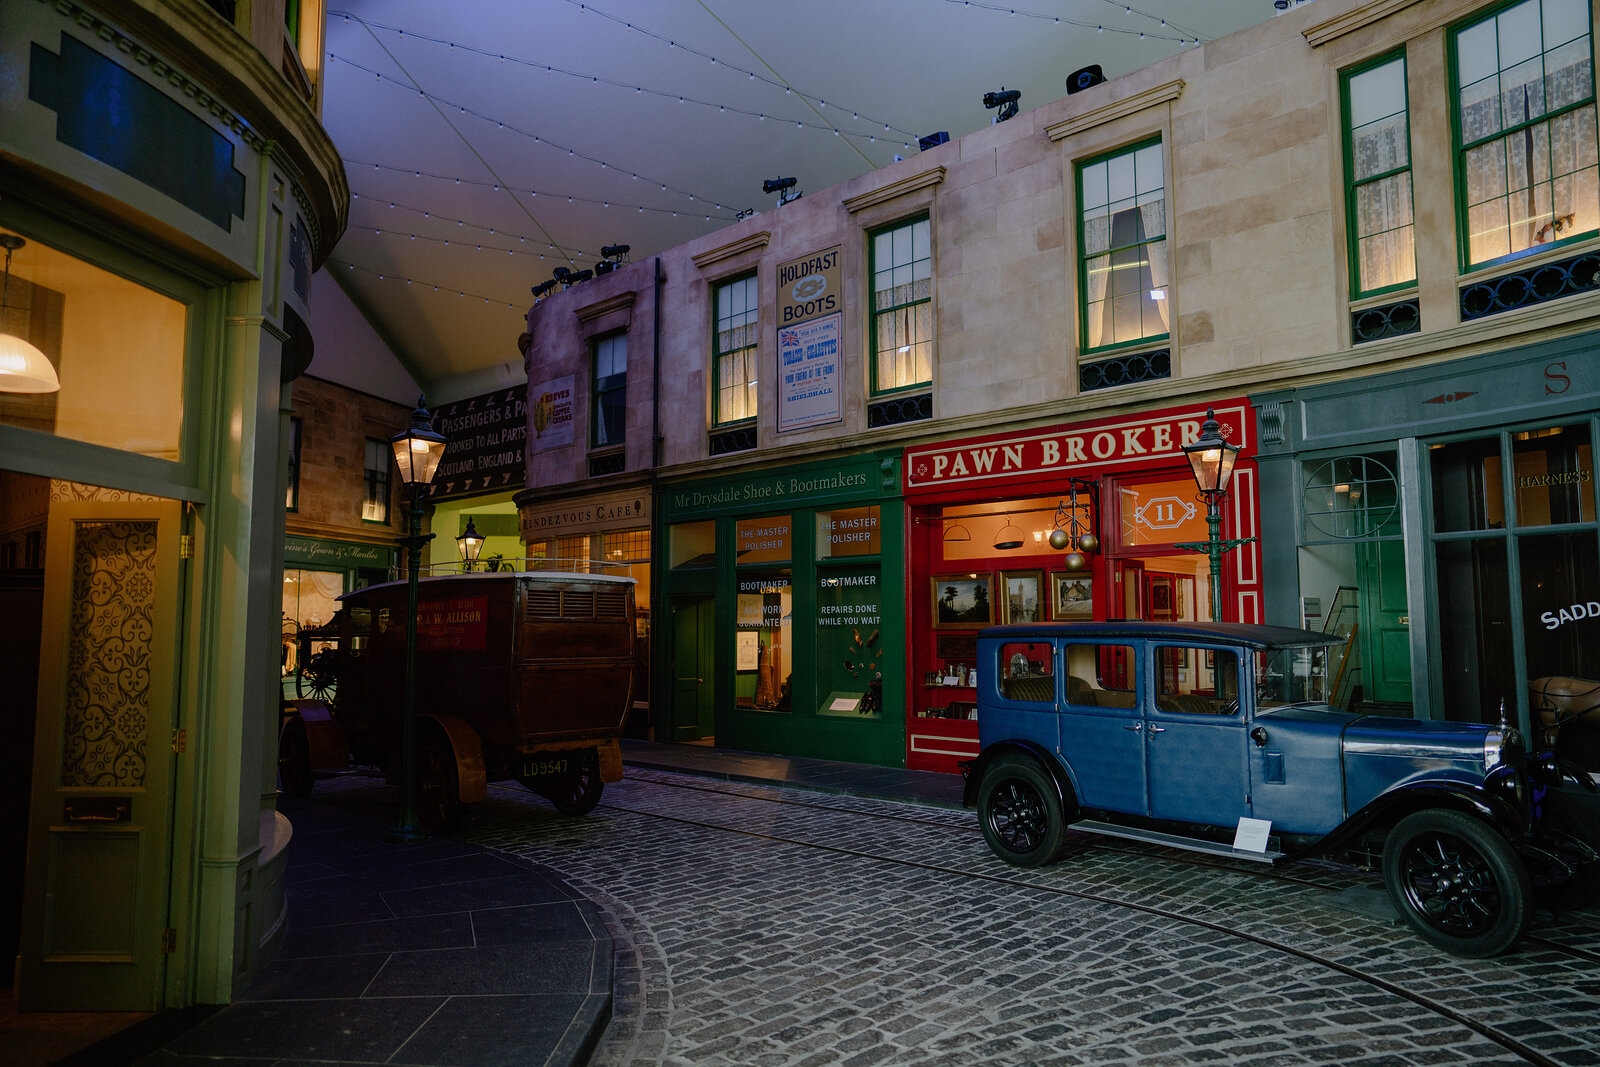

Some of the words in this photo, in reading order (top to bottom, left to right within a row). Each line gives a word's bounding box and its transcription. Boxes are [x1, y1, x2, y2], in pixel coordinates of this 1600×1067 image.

[781, 251, 838, 288] HOLDFAST
[784, 294, 836, 322] BOOTS
[1544, 362, 1570, 395] S
[787, 388, 833, 402] SHIELDHALL
[442, 408, 502, 434] PASSENGERS
[504, 405, 512, 420] &
[447, 437, 474, 455] BOOKED
[476, 435, 485, 448] TO
[486, 431, 500, 446] ALL
[502, 426, 527, 443] PARTS
[932, 444, 1026, 480] PAWN
[1040, 419, 1202, 467] BROKER
[478, 451, 514, 470] ENGLAND
[515, 449, 522, 463] &
[1519, 470, 1590, 489] HARNESS
[674, 495, 690, 508] Mr
[692, 486, 740, 508] Drysdale
[744, 484, 772, 500] Shoe
[775, 481, 786, 495] &
[790, 472, 867, 494] Bootmakers
[522, 511, 591, 530] RENDEZVOUS
[1154, 503, 1175, 522] 11
[820, 520, 837, 530] THE
[840, 517, 877, 529] MASTER
[740, 529, 754, 538] THE
[756, 526, 788, 538] MASTER
[826, 532, 872, 544] POLISHER
[336, 547, 345, 559] &
[344, 546, 378, 560] Mantles
[745, 539, 784, 551] POLISHER
[740, 580, 788, 590] BOOTMAKER
[820, 576, 876, 588] BOOTMAKER
[446, 610, 481, 624] ALLISON
[744, 605, 758, 615] ALL
[761, 604, 785, 615] WORK
[821, 605, 854, 614] REPAIRS
[855, 604, 877, 614] DONE
[1540, 602, 1600, 630] SADD
[818, 617, 842, 626] WHILE
[844, 616, 858, 625] YOU
[860, 616, 881, 625] WAIT
